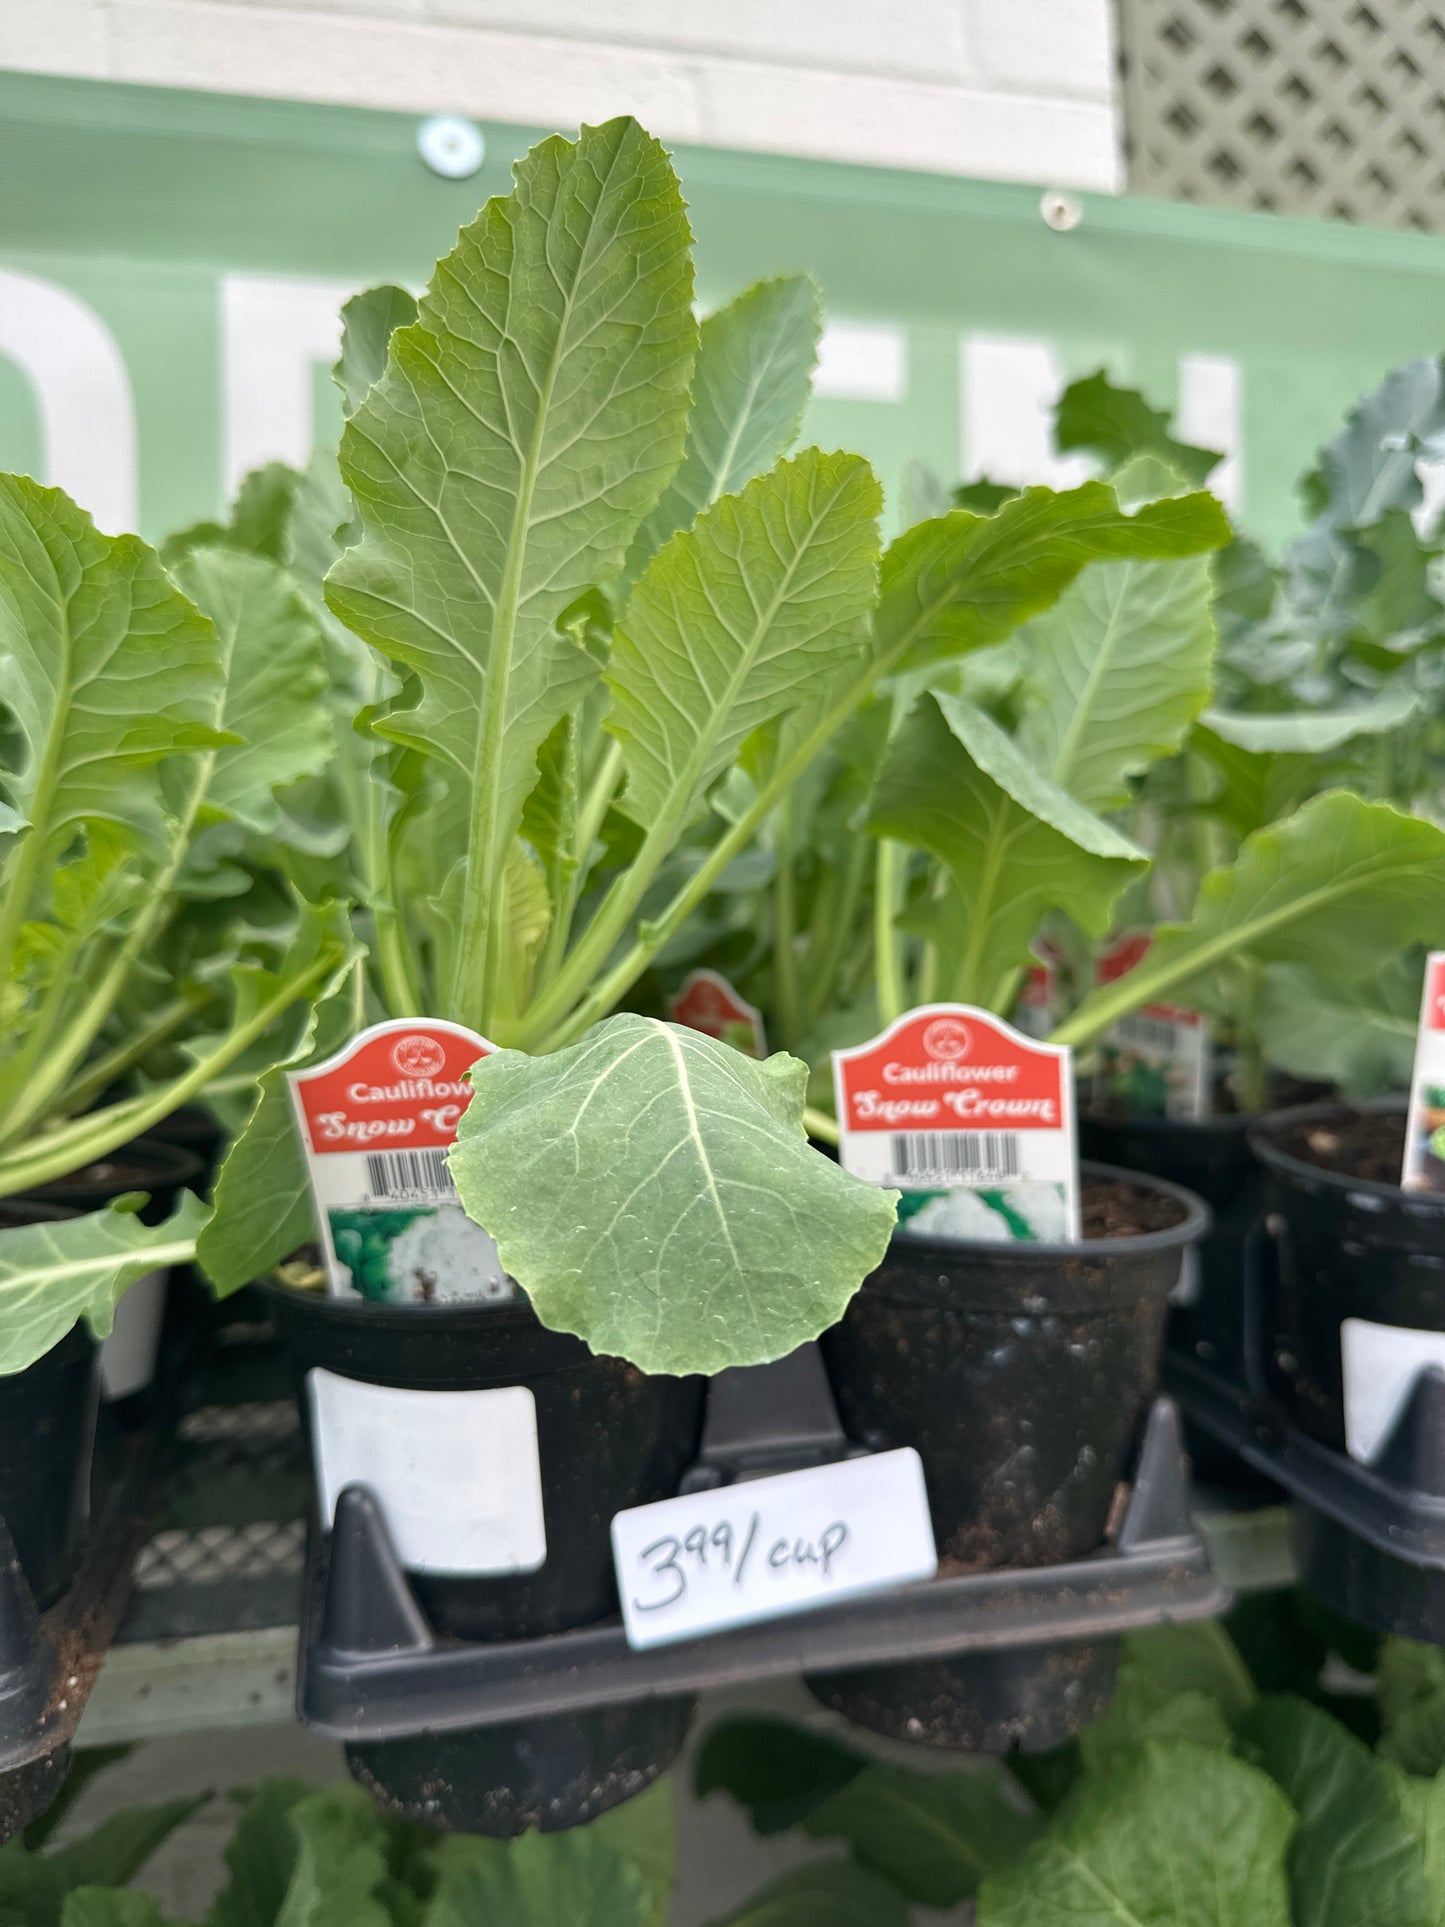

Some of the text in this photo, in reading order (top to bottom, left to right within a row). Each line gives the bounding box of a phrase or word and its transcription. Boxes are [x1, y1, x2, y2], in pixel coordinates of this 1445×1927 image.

[882, 1062, 1020, 1084] Cauliflower
[348, 1079, 472, 1102] Cauliflow
[853, 1088, 1056, 1123] Snow Crown
[317, 1111, 416, 1142] Snow
